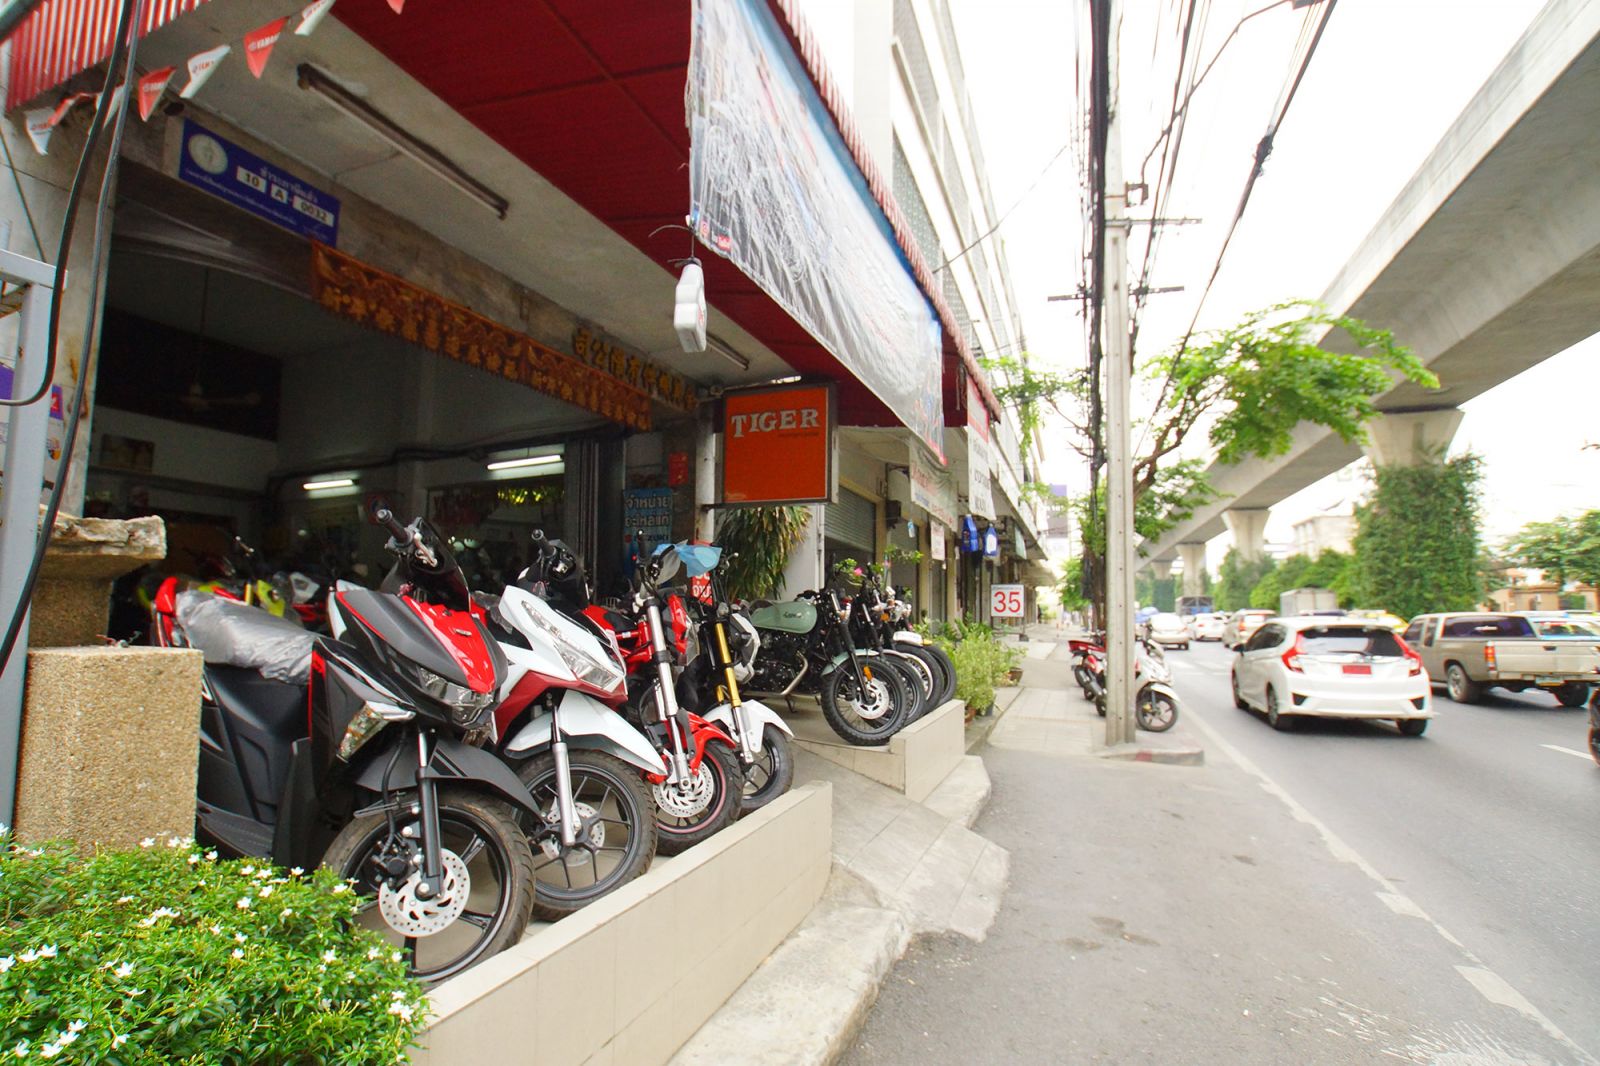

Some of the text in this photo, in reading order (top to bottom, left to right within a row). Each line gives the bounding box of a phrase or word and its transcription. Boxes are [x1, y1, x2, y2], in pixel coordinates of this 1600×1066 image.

[731, 408, 820, 438] TIGER
[624, 493, 669, 509] จำหน่าย
[993, 591, 1021, 613] 35
